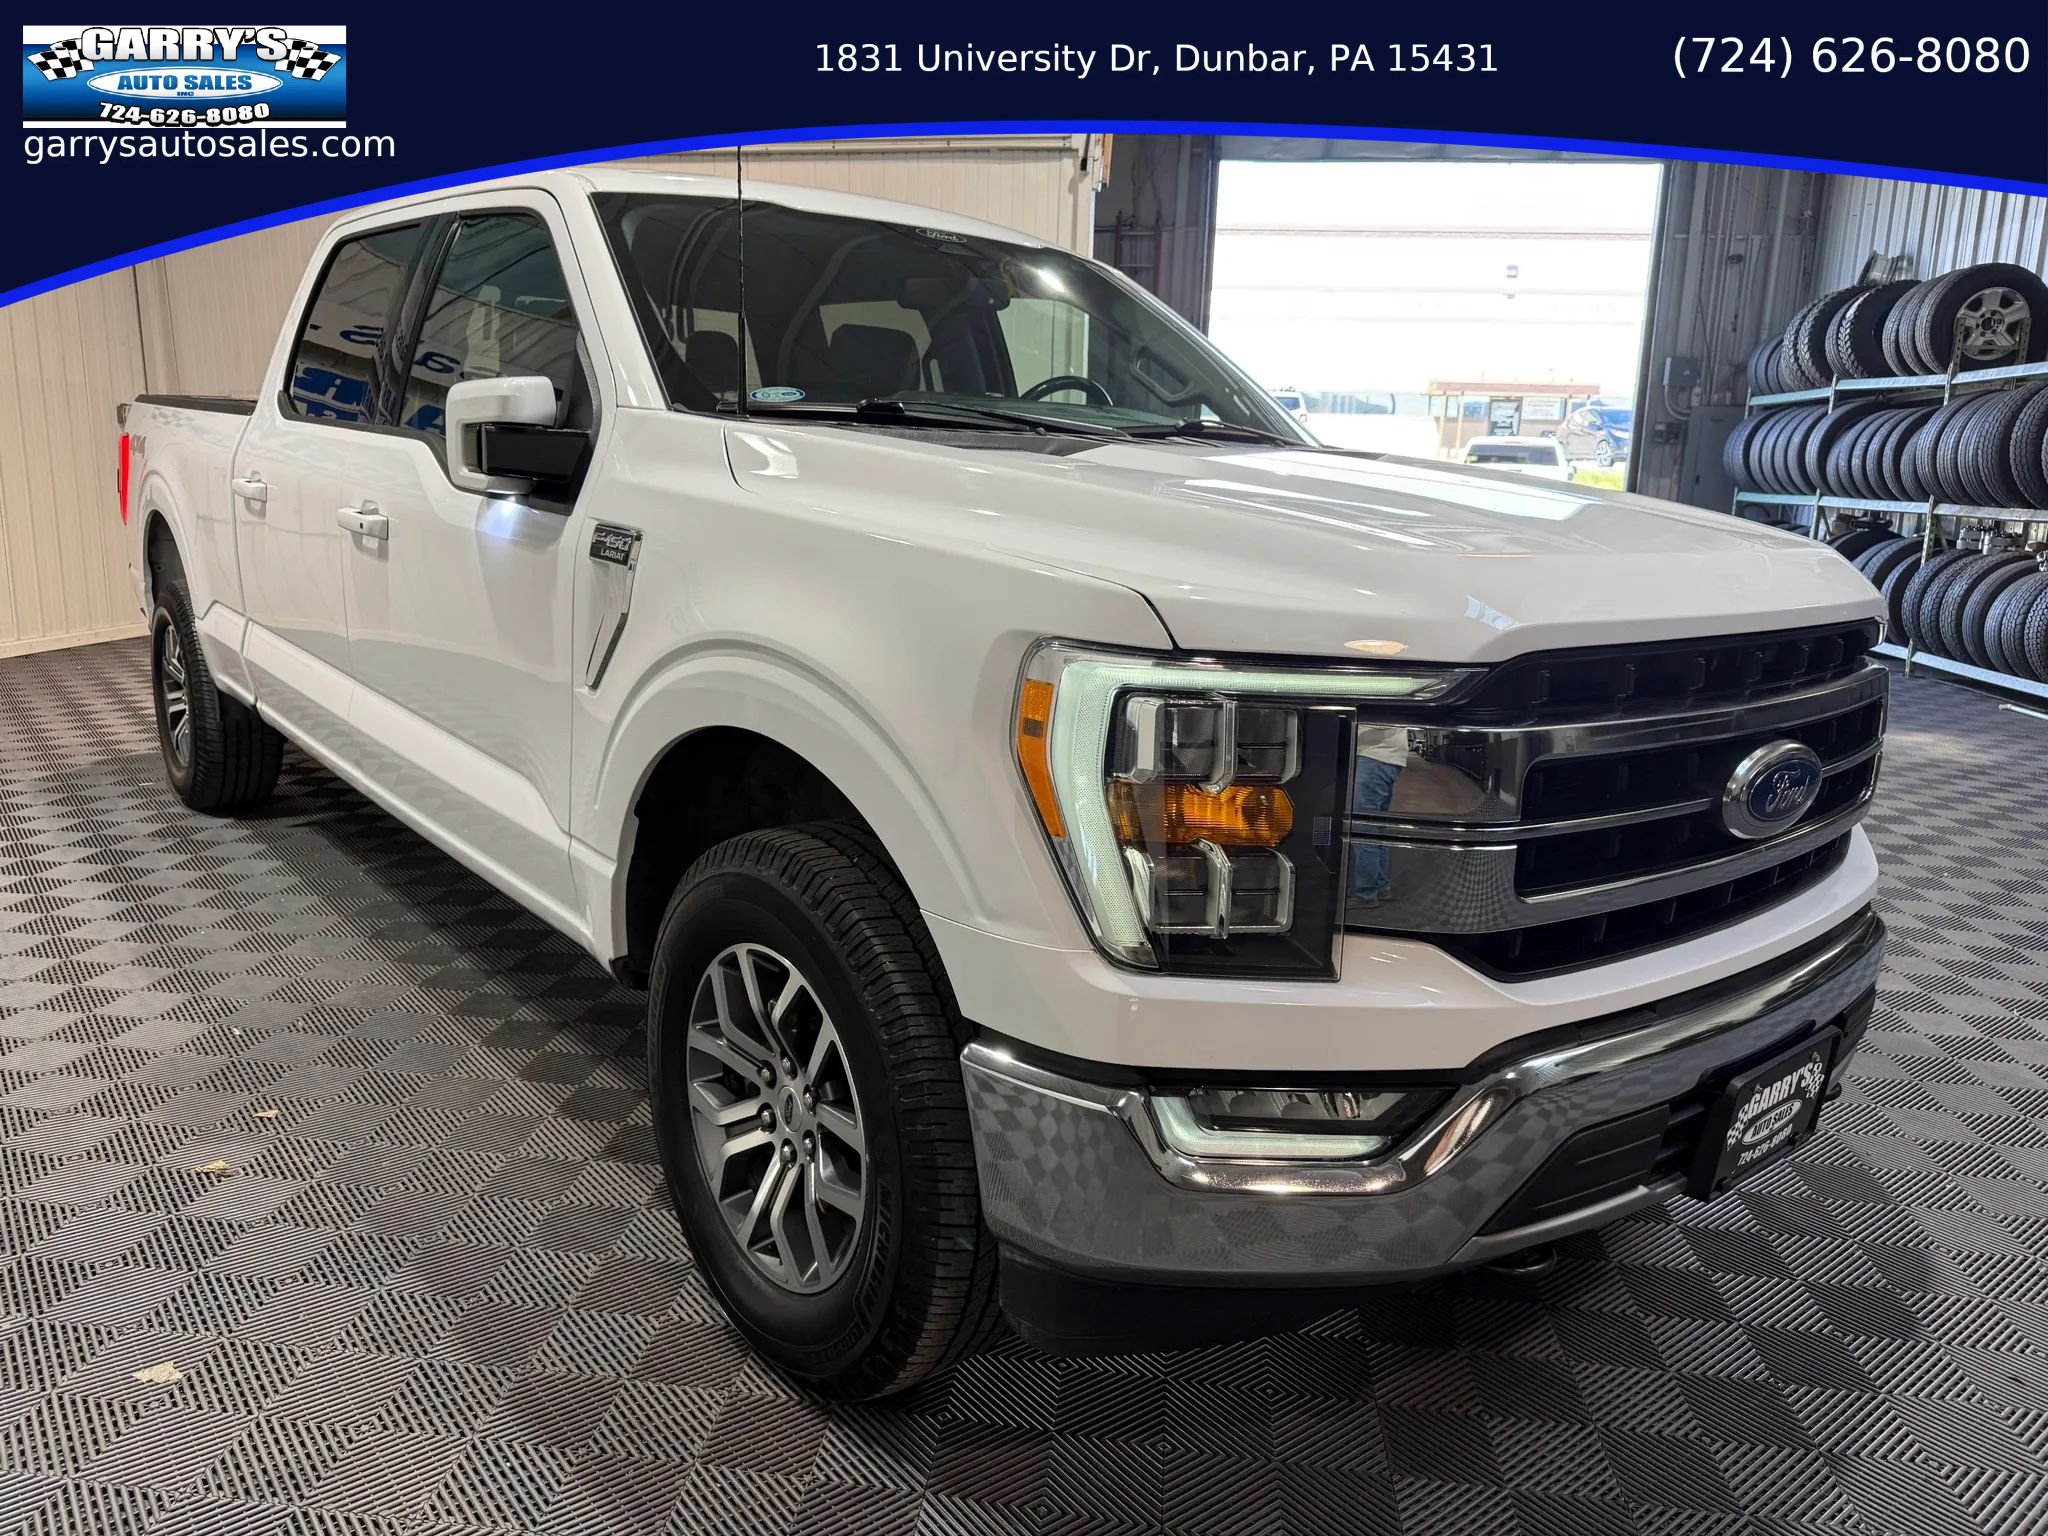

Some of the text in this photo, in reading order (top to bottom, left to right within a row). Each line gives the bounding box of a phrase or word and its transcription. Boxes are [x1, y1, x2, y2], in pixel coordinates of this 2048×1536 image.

[593, 532, 631, 551] F-150
[601, 548, 625, 560] LARIAT
[1765, 768, 1810, 813] Ford
[1747, 1062, 1814, 1119] GARRY'S
[1750, 1103, 1794, 1139] AUTO SALES
